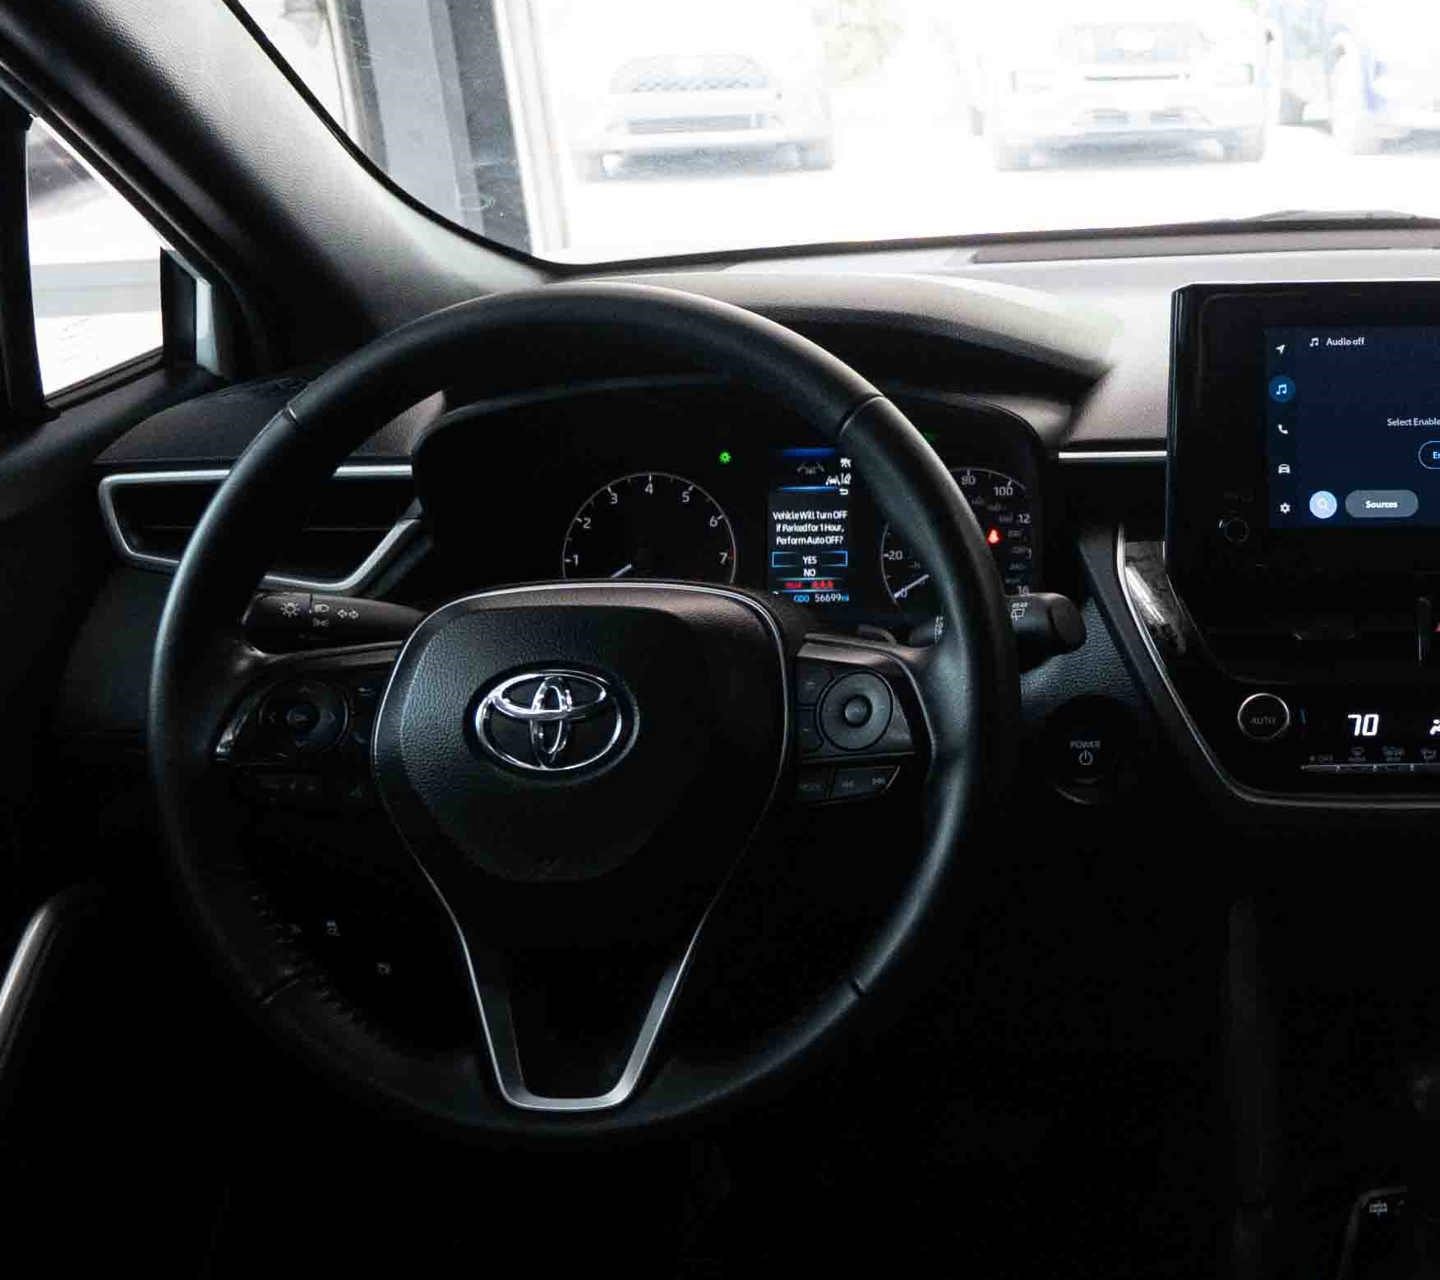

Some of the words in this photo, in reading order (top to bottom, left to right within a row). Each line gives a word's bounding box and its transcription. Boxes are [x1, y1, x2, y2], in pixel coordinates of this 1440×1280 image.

[1325, 336, 1350, 346] Audio
[1351, 336, 1366, 346] off
[1387, 417, 1412, 426] Select
[644, 483, 653, 496] 4
[993, 486, 1014, 497] 100
[610, 493, 619, 505] 3
[681, 491, 690, 503] 5
[1365, 499, 1398, 509] Sources
[772, 511, 799, 520] Vehicle
[816, 511, 833, 520] Turn
[833, 510, 848, 520] OFF
[582, 517, 592, 529] 2
[709, 515, 719, 528] 6
[776, 535, 806, 545] Perform
[806, 535, 825, 545] Auto
[825, 535, 844, 545] OFF?
[719, 552, 728, 565] 7
[802, 555, 818, 565] YES
[888, 549, 903, 560] 20
[803, 568, 816, 577] NO
[814, 593, 842, 603] 56699
[1347, 713, 1380, 737] 70
